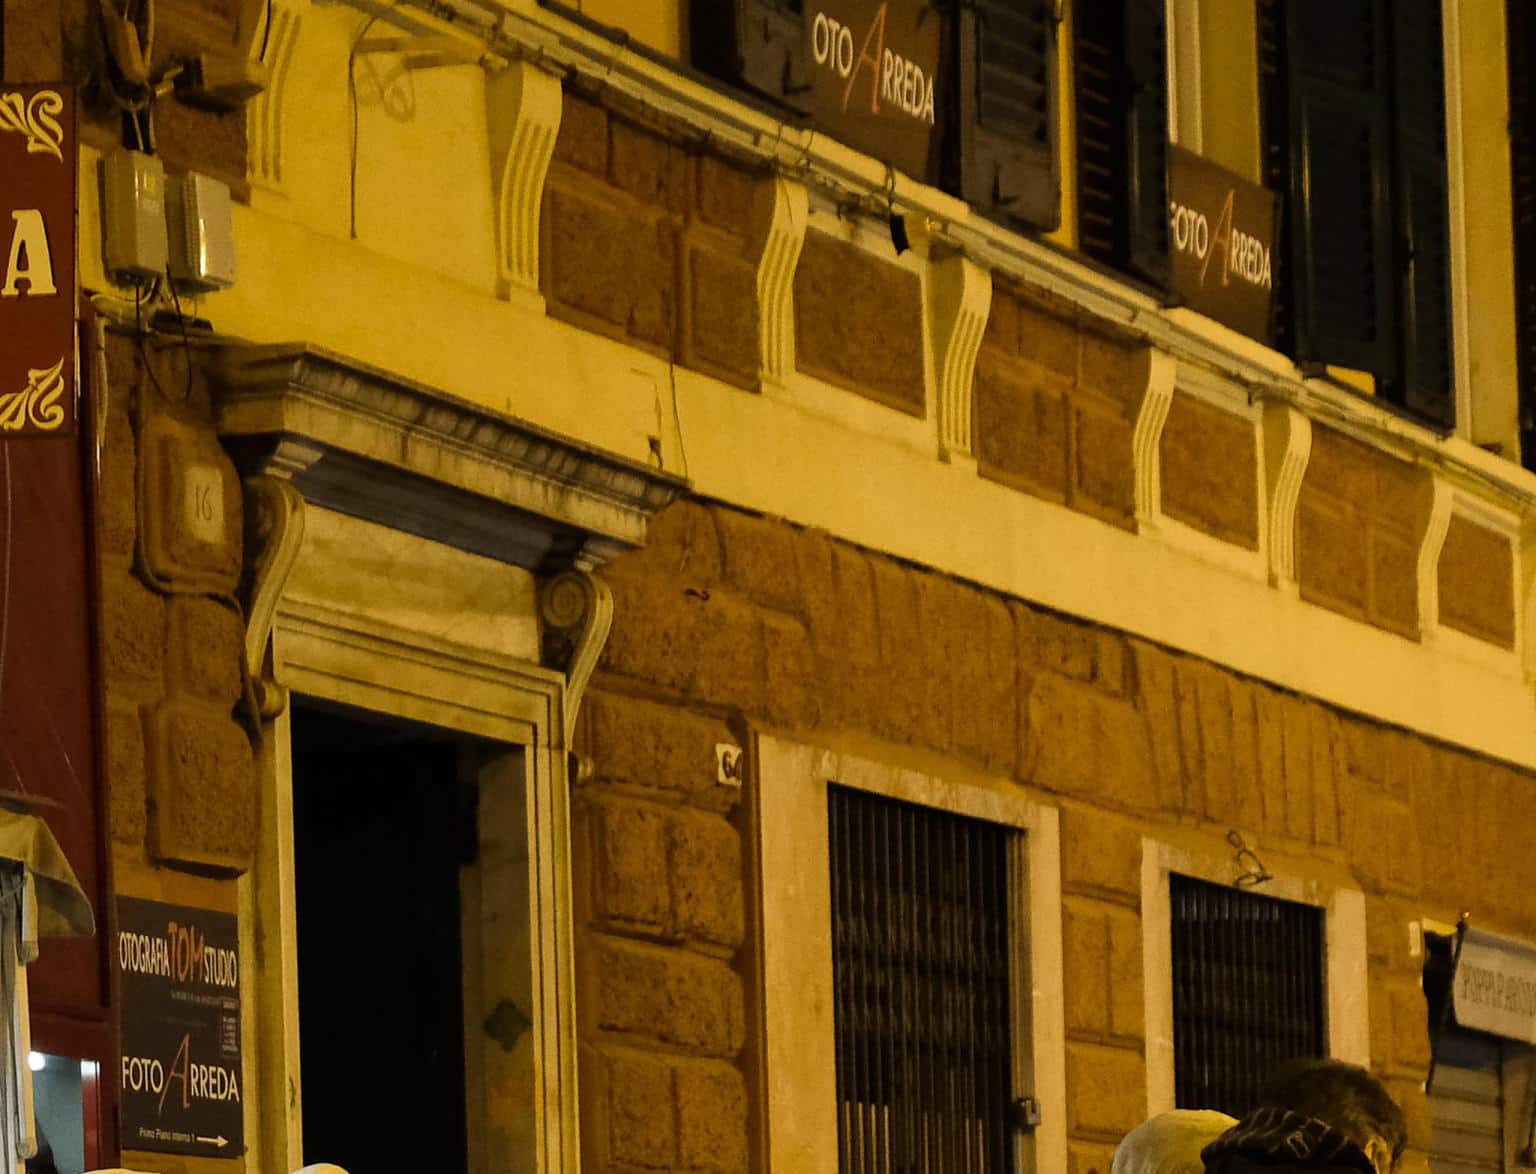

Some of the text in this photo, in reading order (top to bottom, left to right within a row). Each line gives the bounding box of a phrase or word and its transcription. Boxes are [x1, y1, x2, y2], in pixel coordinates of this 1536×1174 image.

[811, 11, 854, 78] OTO
[117, 930, 170, 977] OTOGRAFIA
[204, 945, 237, 987] STUDIO
[121, 1055, 164, 1094] FOTO
